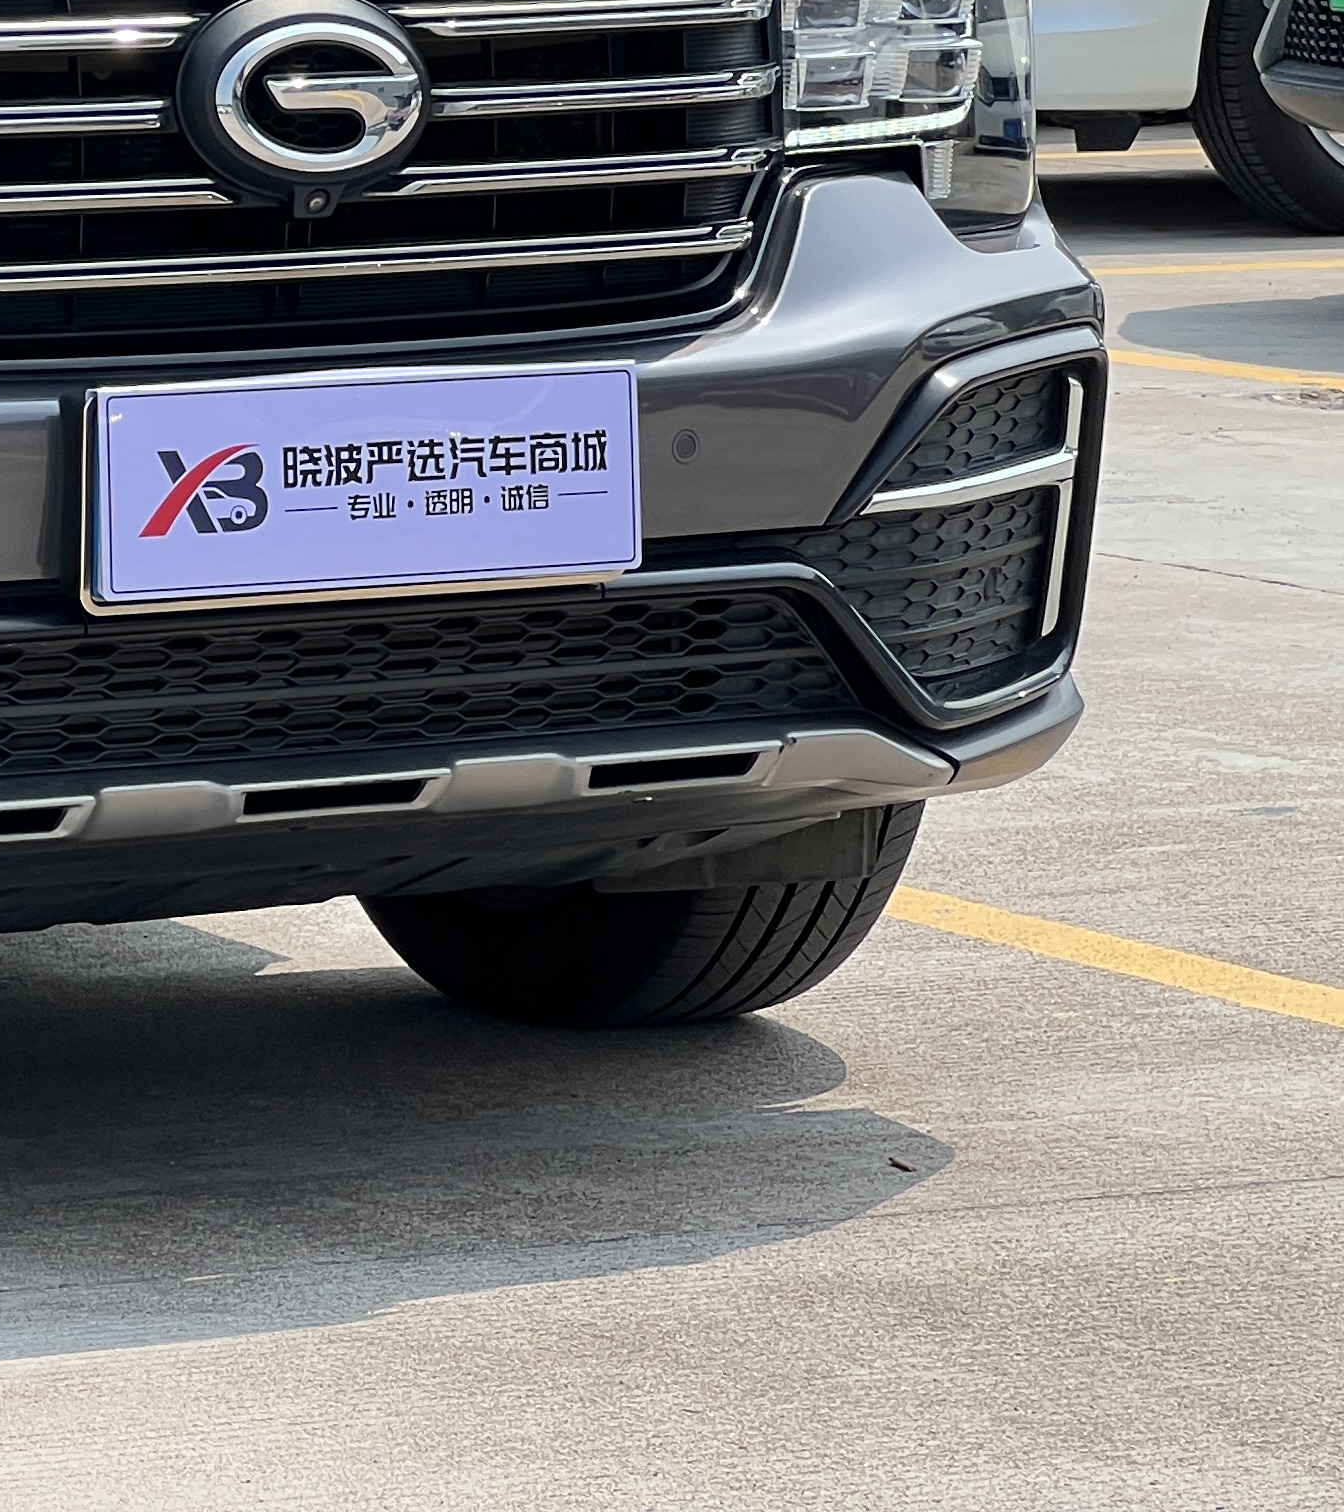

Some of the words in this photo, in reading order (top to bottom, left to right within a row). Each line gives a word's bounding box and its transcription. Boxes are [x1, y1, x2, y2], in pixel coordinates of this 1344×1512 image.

[282, 429, 608, 489] 晓波严选汽车商城
